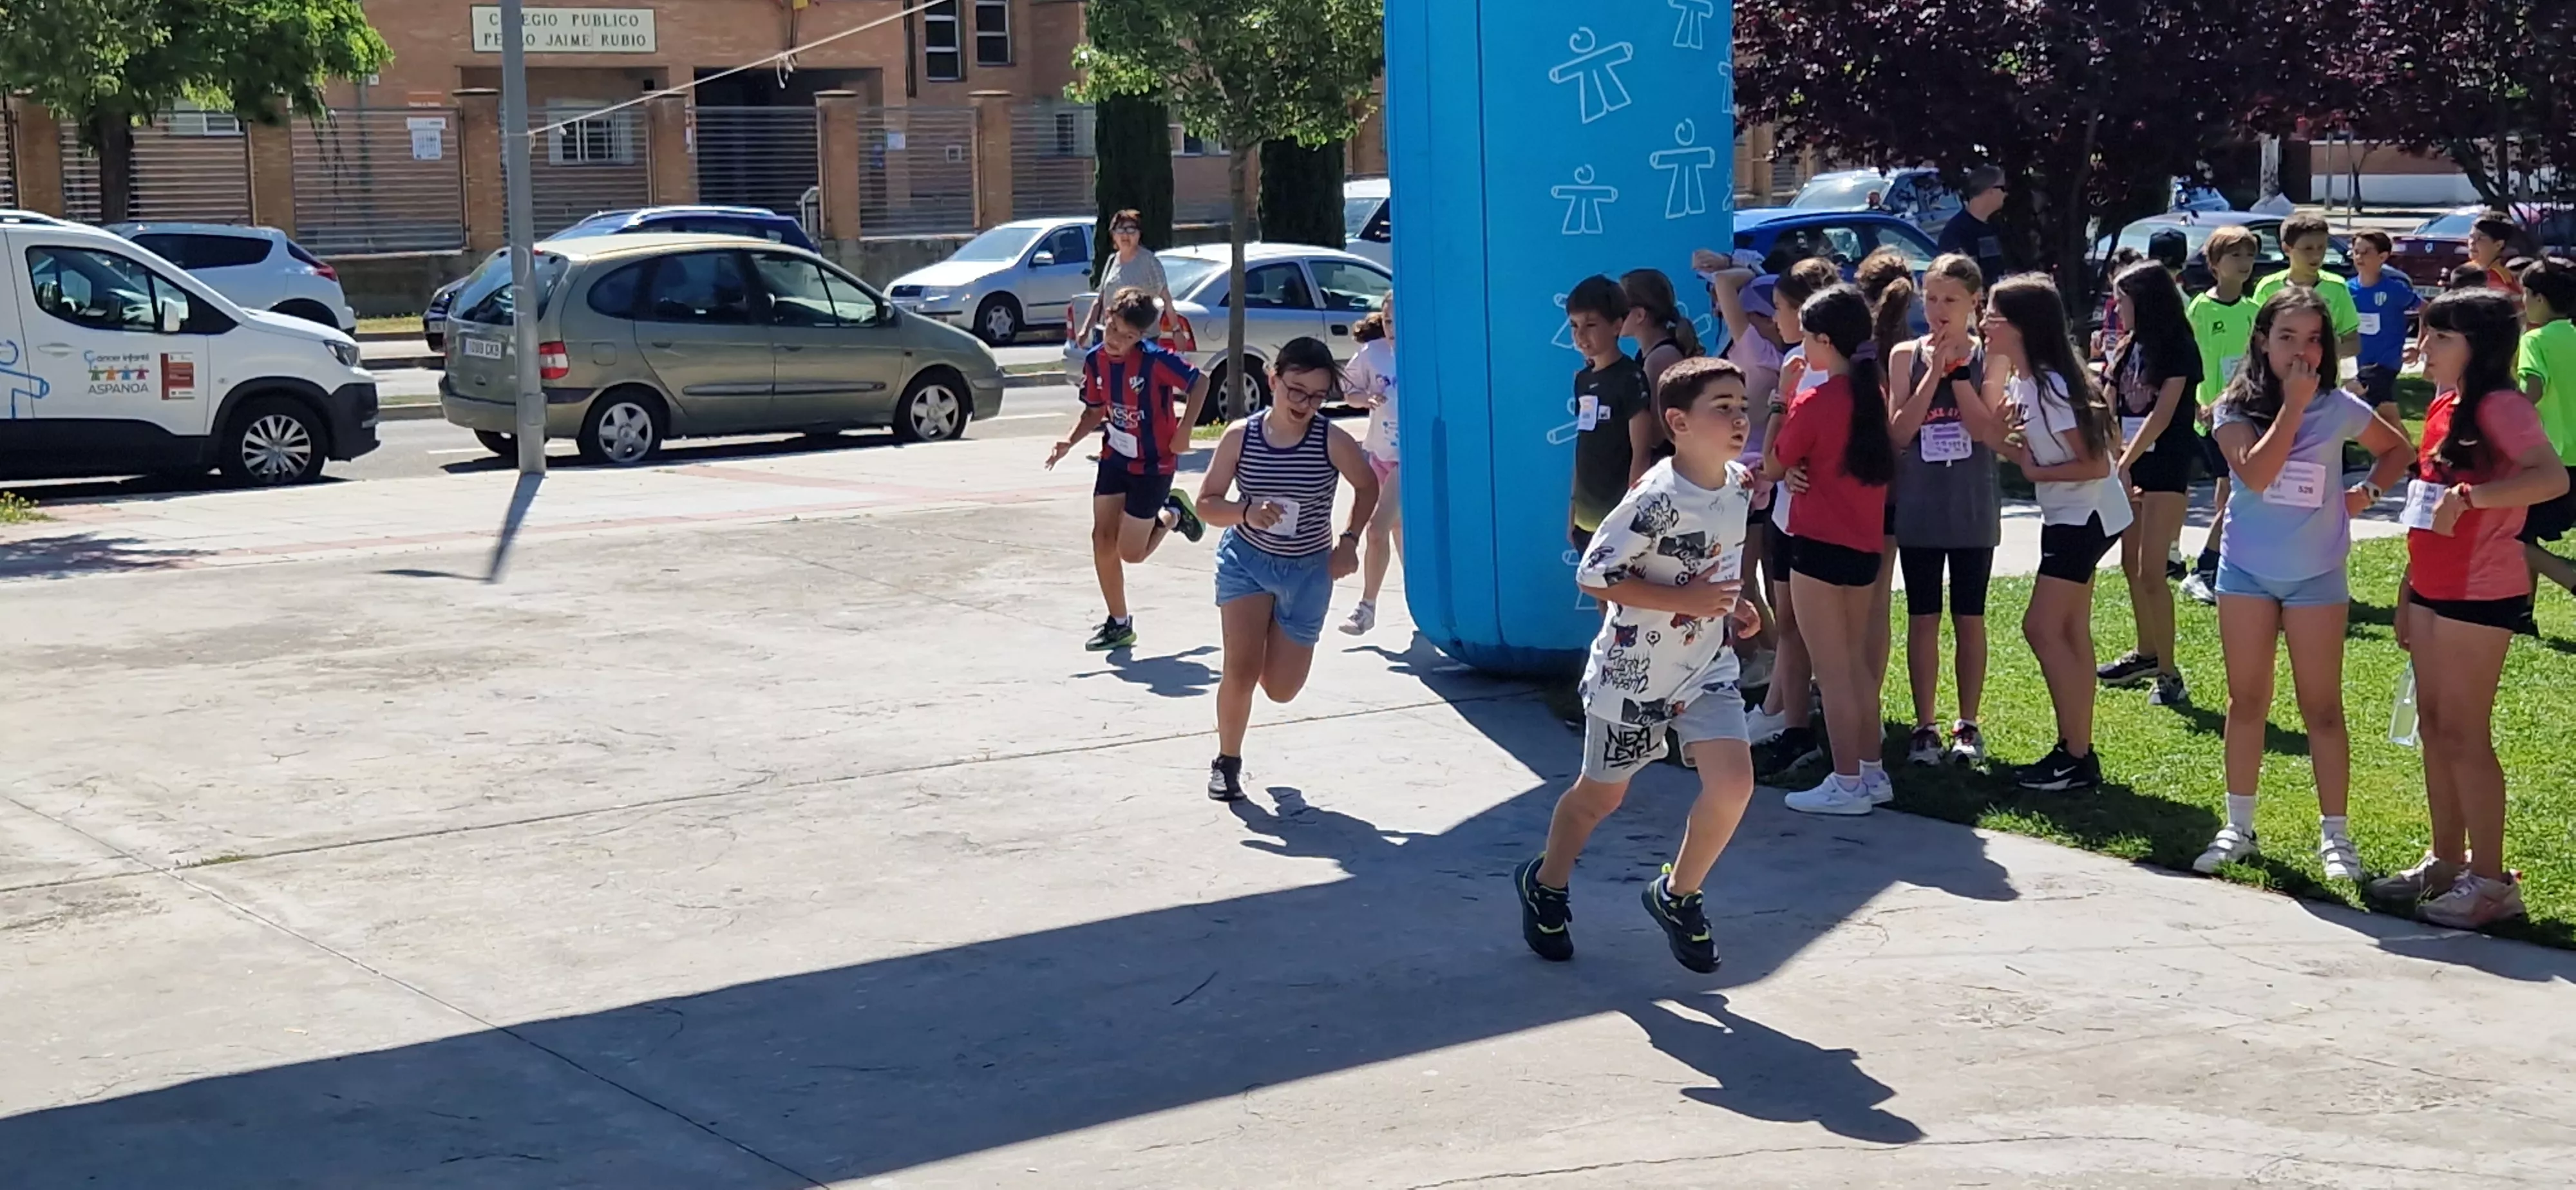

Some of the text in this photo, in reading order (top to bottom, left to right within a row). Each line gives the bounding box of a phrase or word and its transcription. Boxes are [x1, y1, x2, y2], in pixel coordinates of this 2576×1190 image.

[489, 13, 639, 28] CEGIO PUBLICO
[484, 32, 647, 47] PEO JAIME RUBIO
[88, 383, 149, 395] ASPANOA
